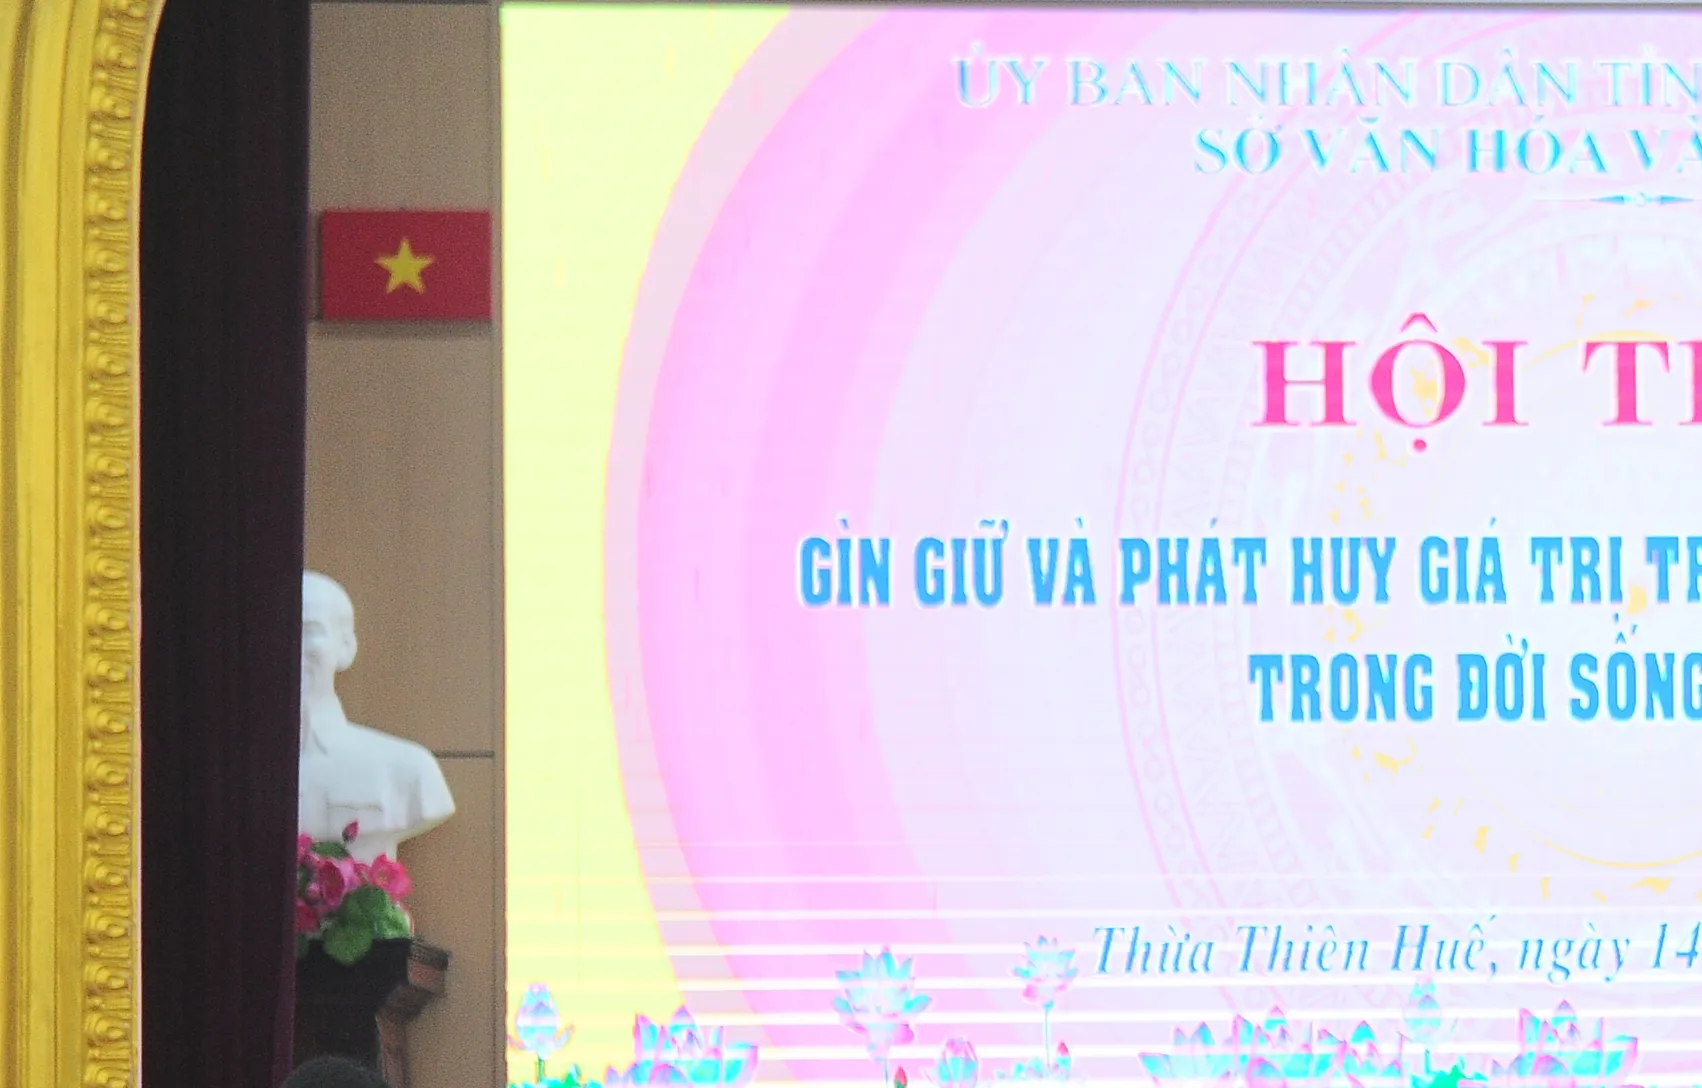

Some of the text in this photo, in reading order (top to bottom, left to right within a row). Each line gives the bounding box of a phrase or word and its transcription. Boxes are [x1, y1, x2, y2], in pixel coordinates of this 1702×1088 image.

[1067, 57, 1206, 106] BAN
[1302, 115, 1440, 174] VĂN
[1465, 114, 1610, 174] HÓA
[1251, 312, 1529, 453] HỘI
[800, 518, 891, 607] GÌN
[914, 520, 1009, 607] GIỮ
[1027, 518, 1097, 606] VÀ
[1119, 518, 1267, 606] PHÁT
[1291, 536, 1397, 606] HUY
[1419, 517, 1509, 606] GIÁ
[1530, 536, 1623, 623] TRỊ
[1248, 653, 1433, 722] TRONG
[1455, 633, 1545, 721] ĐỜI
[1093, 924, 1214, 975] Thừa
[1237, 924, 1369, 973] Thiên
[1390, 914, 1499, 978] Huế,
[1518, 921, 1630, 983] ngày
[1651, 921, 1702, 968] 14
